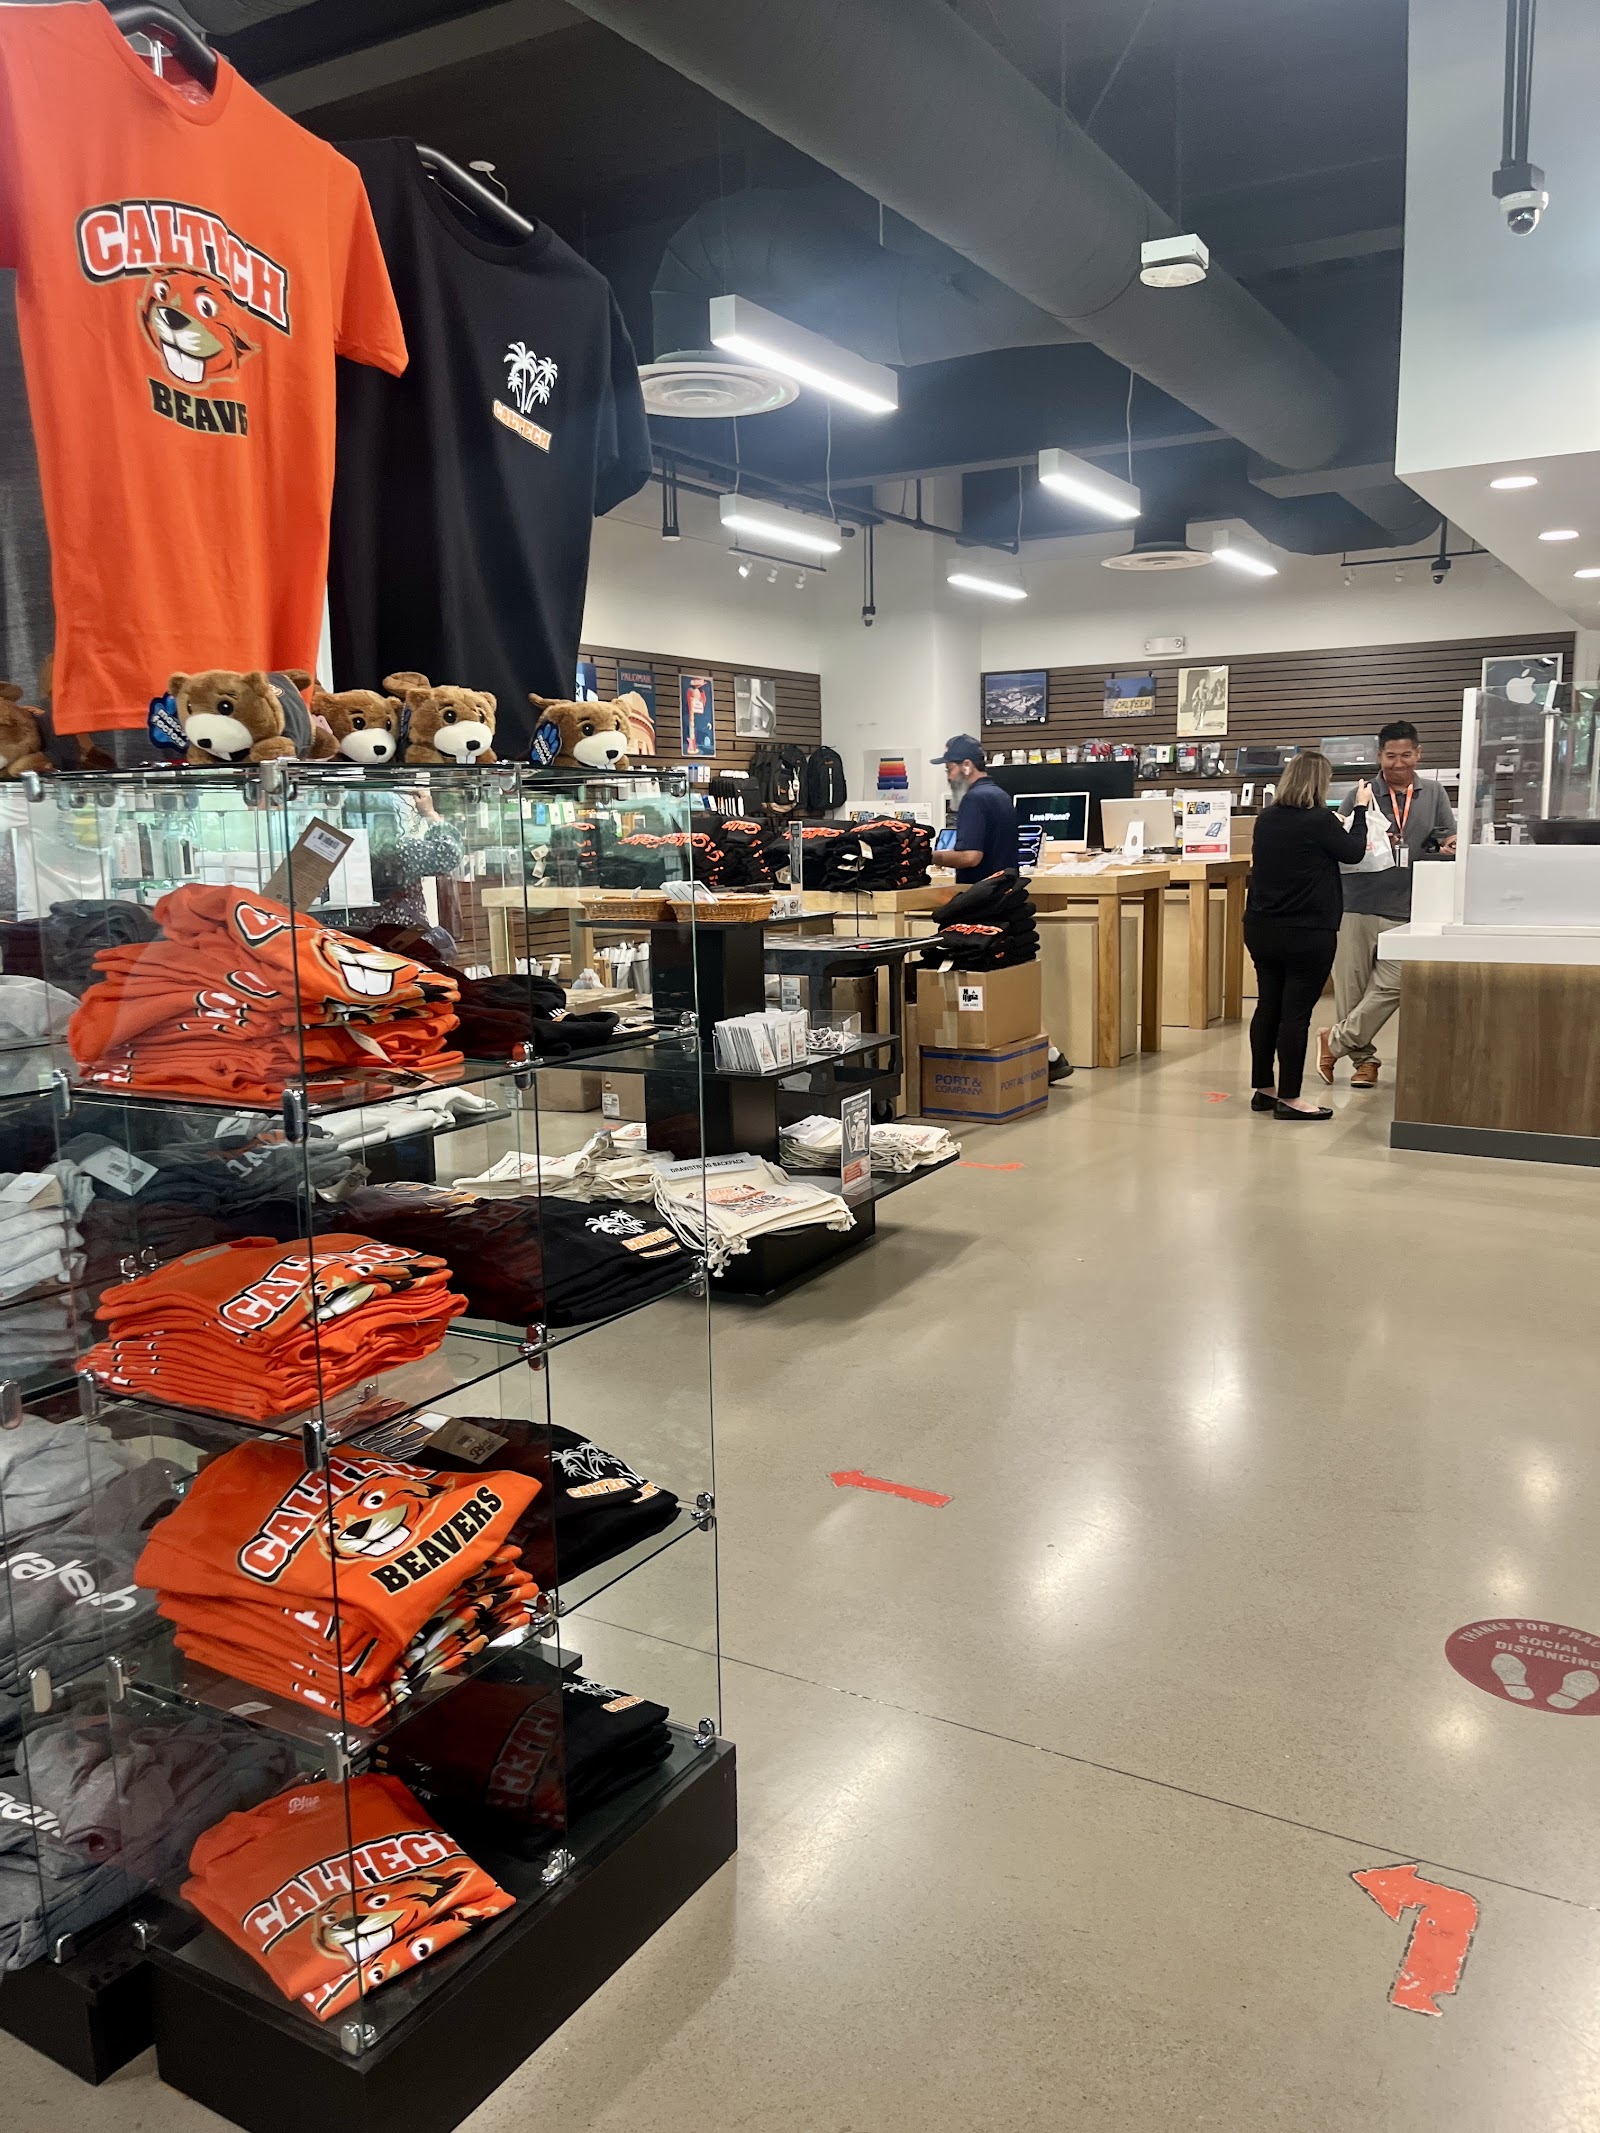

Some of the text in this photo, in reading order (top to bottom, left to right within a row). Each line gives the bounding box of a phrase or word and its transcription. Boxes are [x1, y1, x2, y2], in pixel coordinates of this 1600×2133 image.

[76, 200, 292, 336] CALTECH
[493, 398, 552, 453] CALTECH
[935, 1075, 981, 1087] PORT &
[935, 1085, 981, 1095] COMPANY
[1001, 1080, 1016, 1091] PORT
[713, 1159, 746, 1168] BACKPACK
[620, 1227, 677, 1253] CALTEC
[566, 1478, 633, 1499] CALTEC
[370, 1486, 504, 1596] BEAVERS
[1458, 1622, 1511, 1643] THANKS
[1515, 1622, 1550, 1633] FOR
[1495, 1641, 1600, 1669] DISTANCING
[1519, 1635, 1581, 1655] SOCIAL
[288, 1795, 320, 1815] Blue
